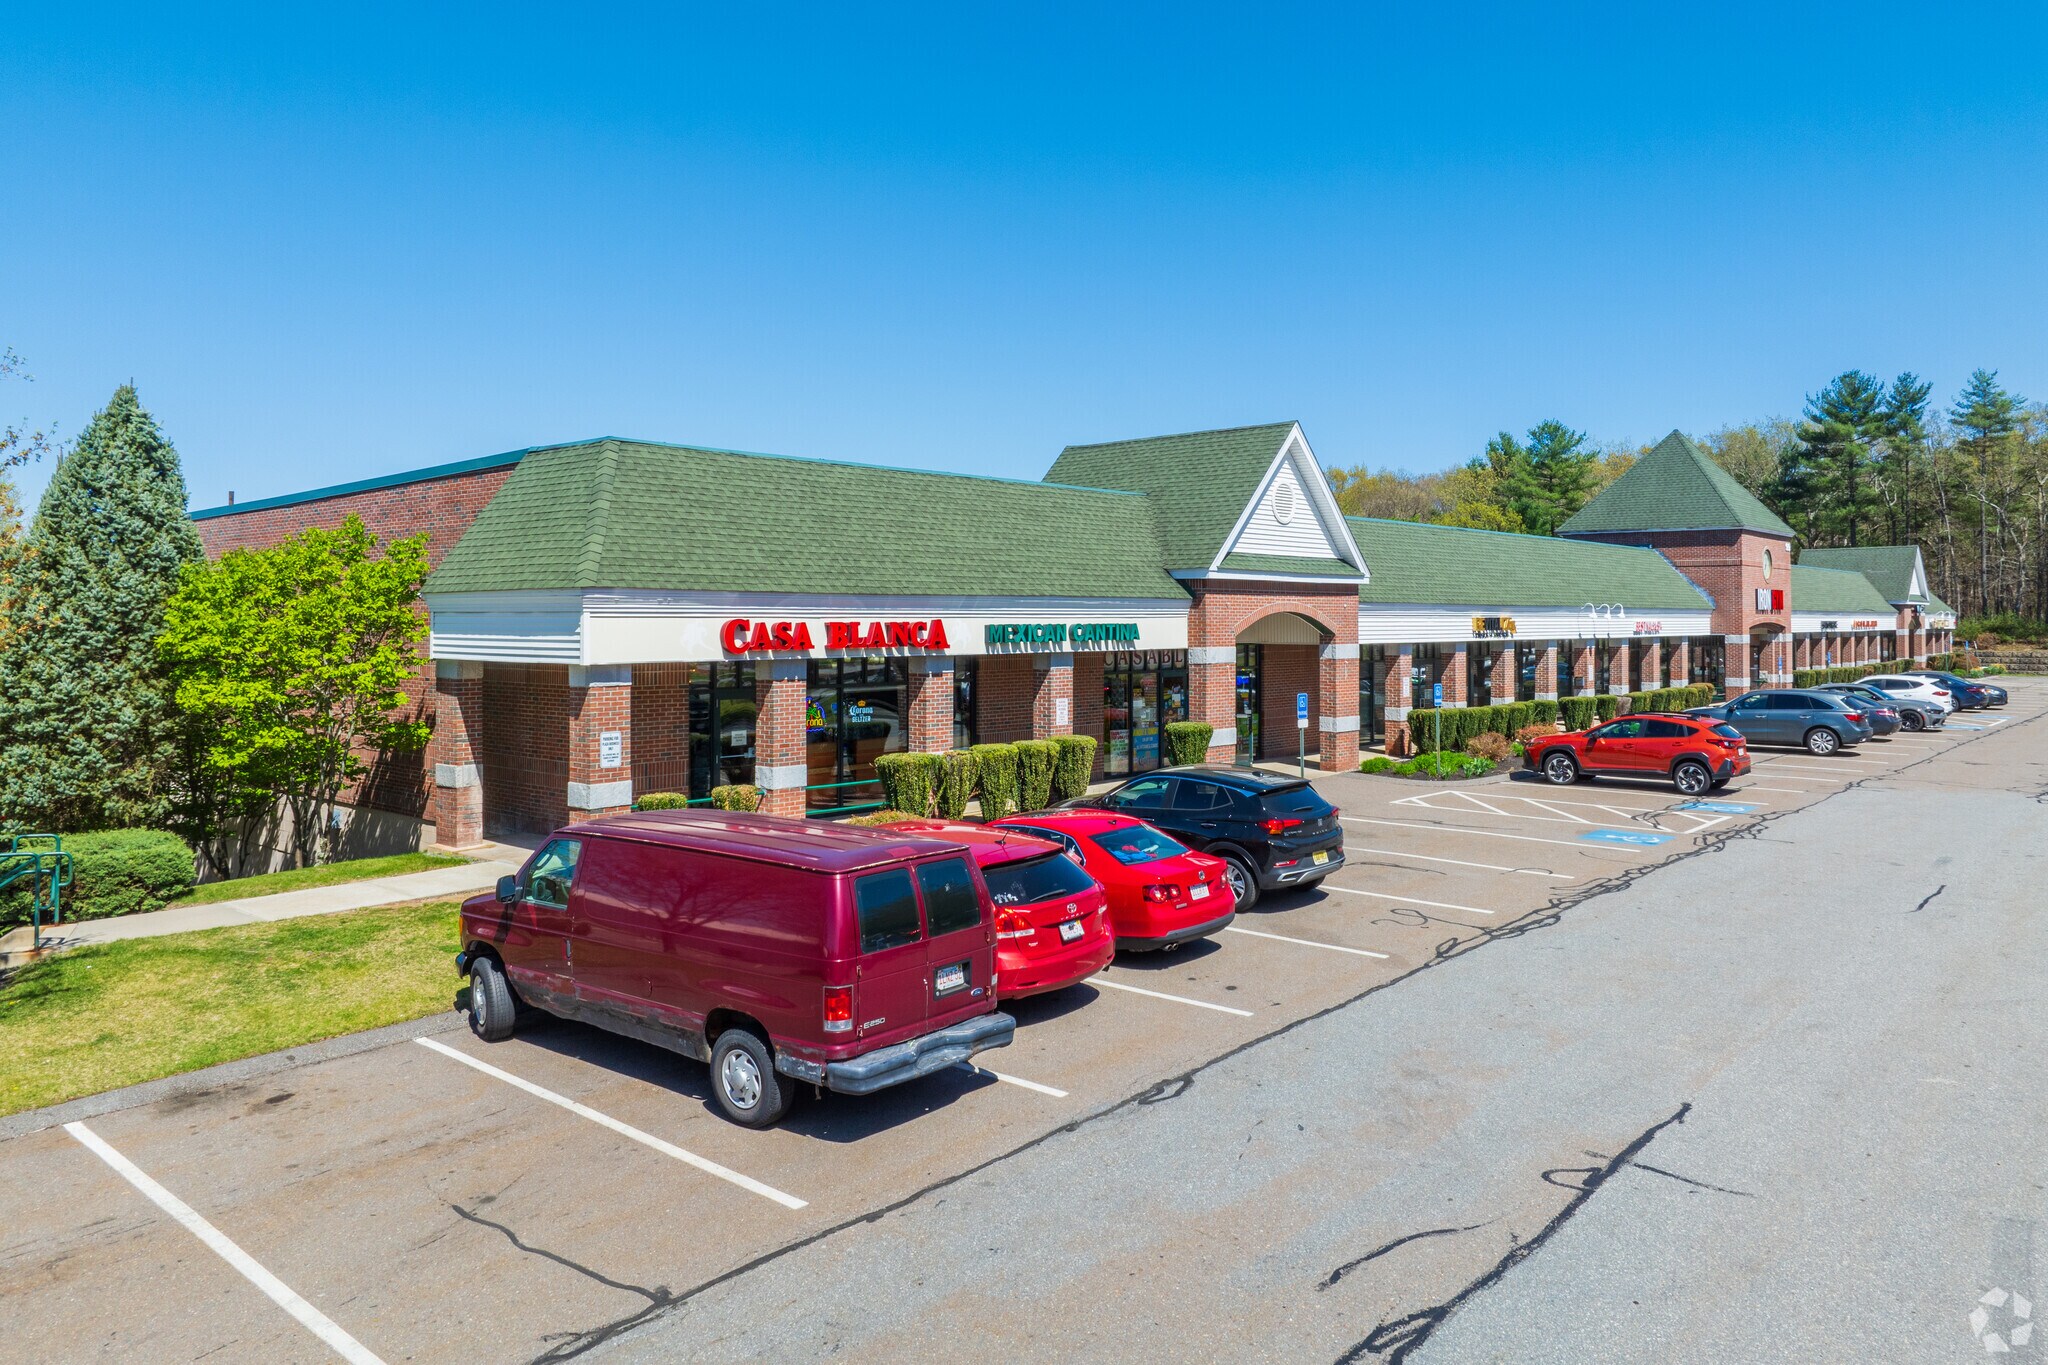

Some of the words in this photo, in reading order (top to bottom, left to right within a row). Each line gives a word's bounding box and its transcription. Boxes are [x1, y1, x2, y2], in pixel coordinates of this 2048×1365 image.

[720, 619, 815, 655] CASA
[824, 619, 951, 650] BLANCA
[984, 623, 1067, 643] MEXICAN
[1069, 623, 1140, 642] CANTINA
[806, 718, 823, 727] rona
